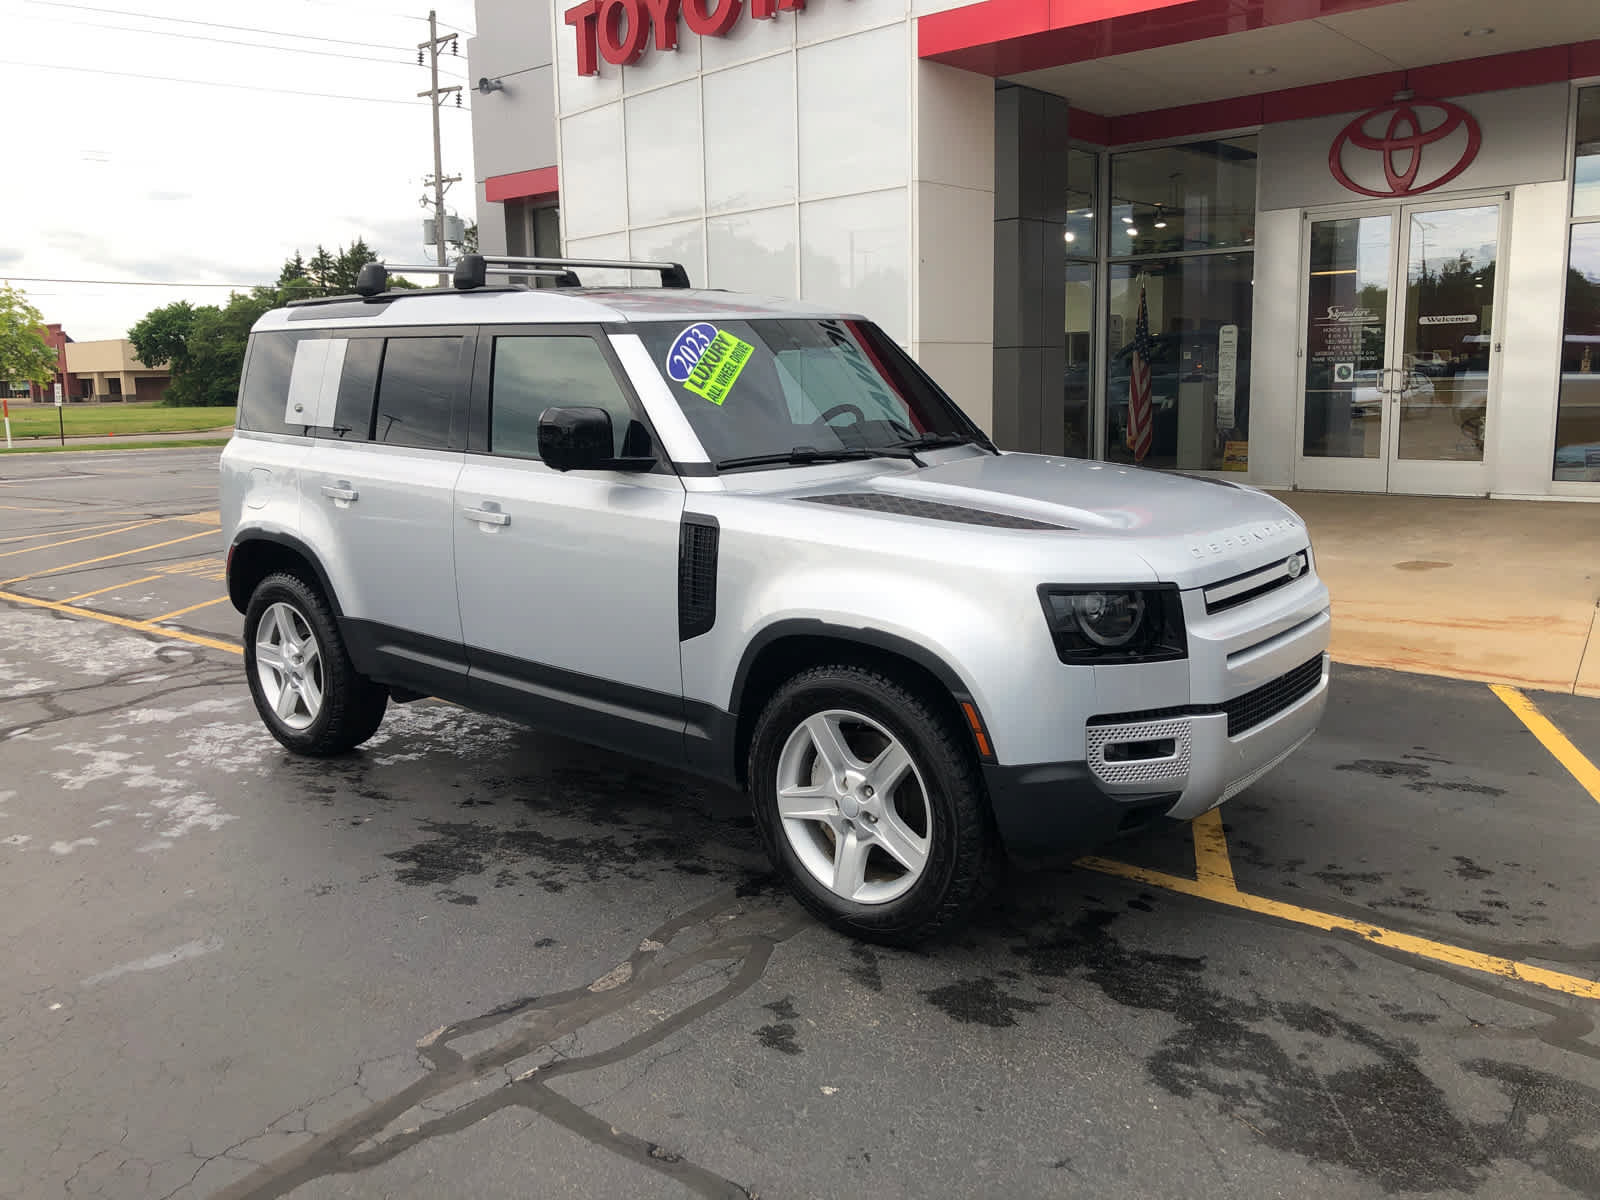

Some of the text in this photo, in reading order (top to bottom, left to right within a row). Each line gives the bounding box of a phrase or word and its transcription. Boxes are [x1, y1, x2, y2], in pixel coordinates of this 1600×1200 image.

[565, 0, 805, 76] TOY
[1427, 315, 1469, 323] Welcome
[673, 328, 711, 375] 2023
[688, 333, 732, 389] LUXURY
[706, 341, 749, 402] ALL WHEEL DRIVE
[1191, 519, 1296, 559] DEFENDER
